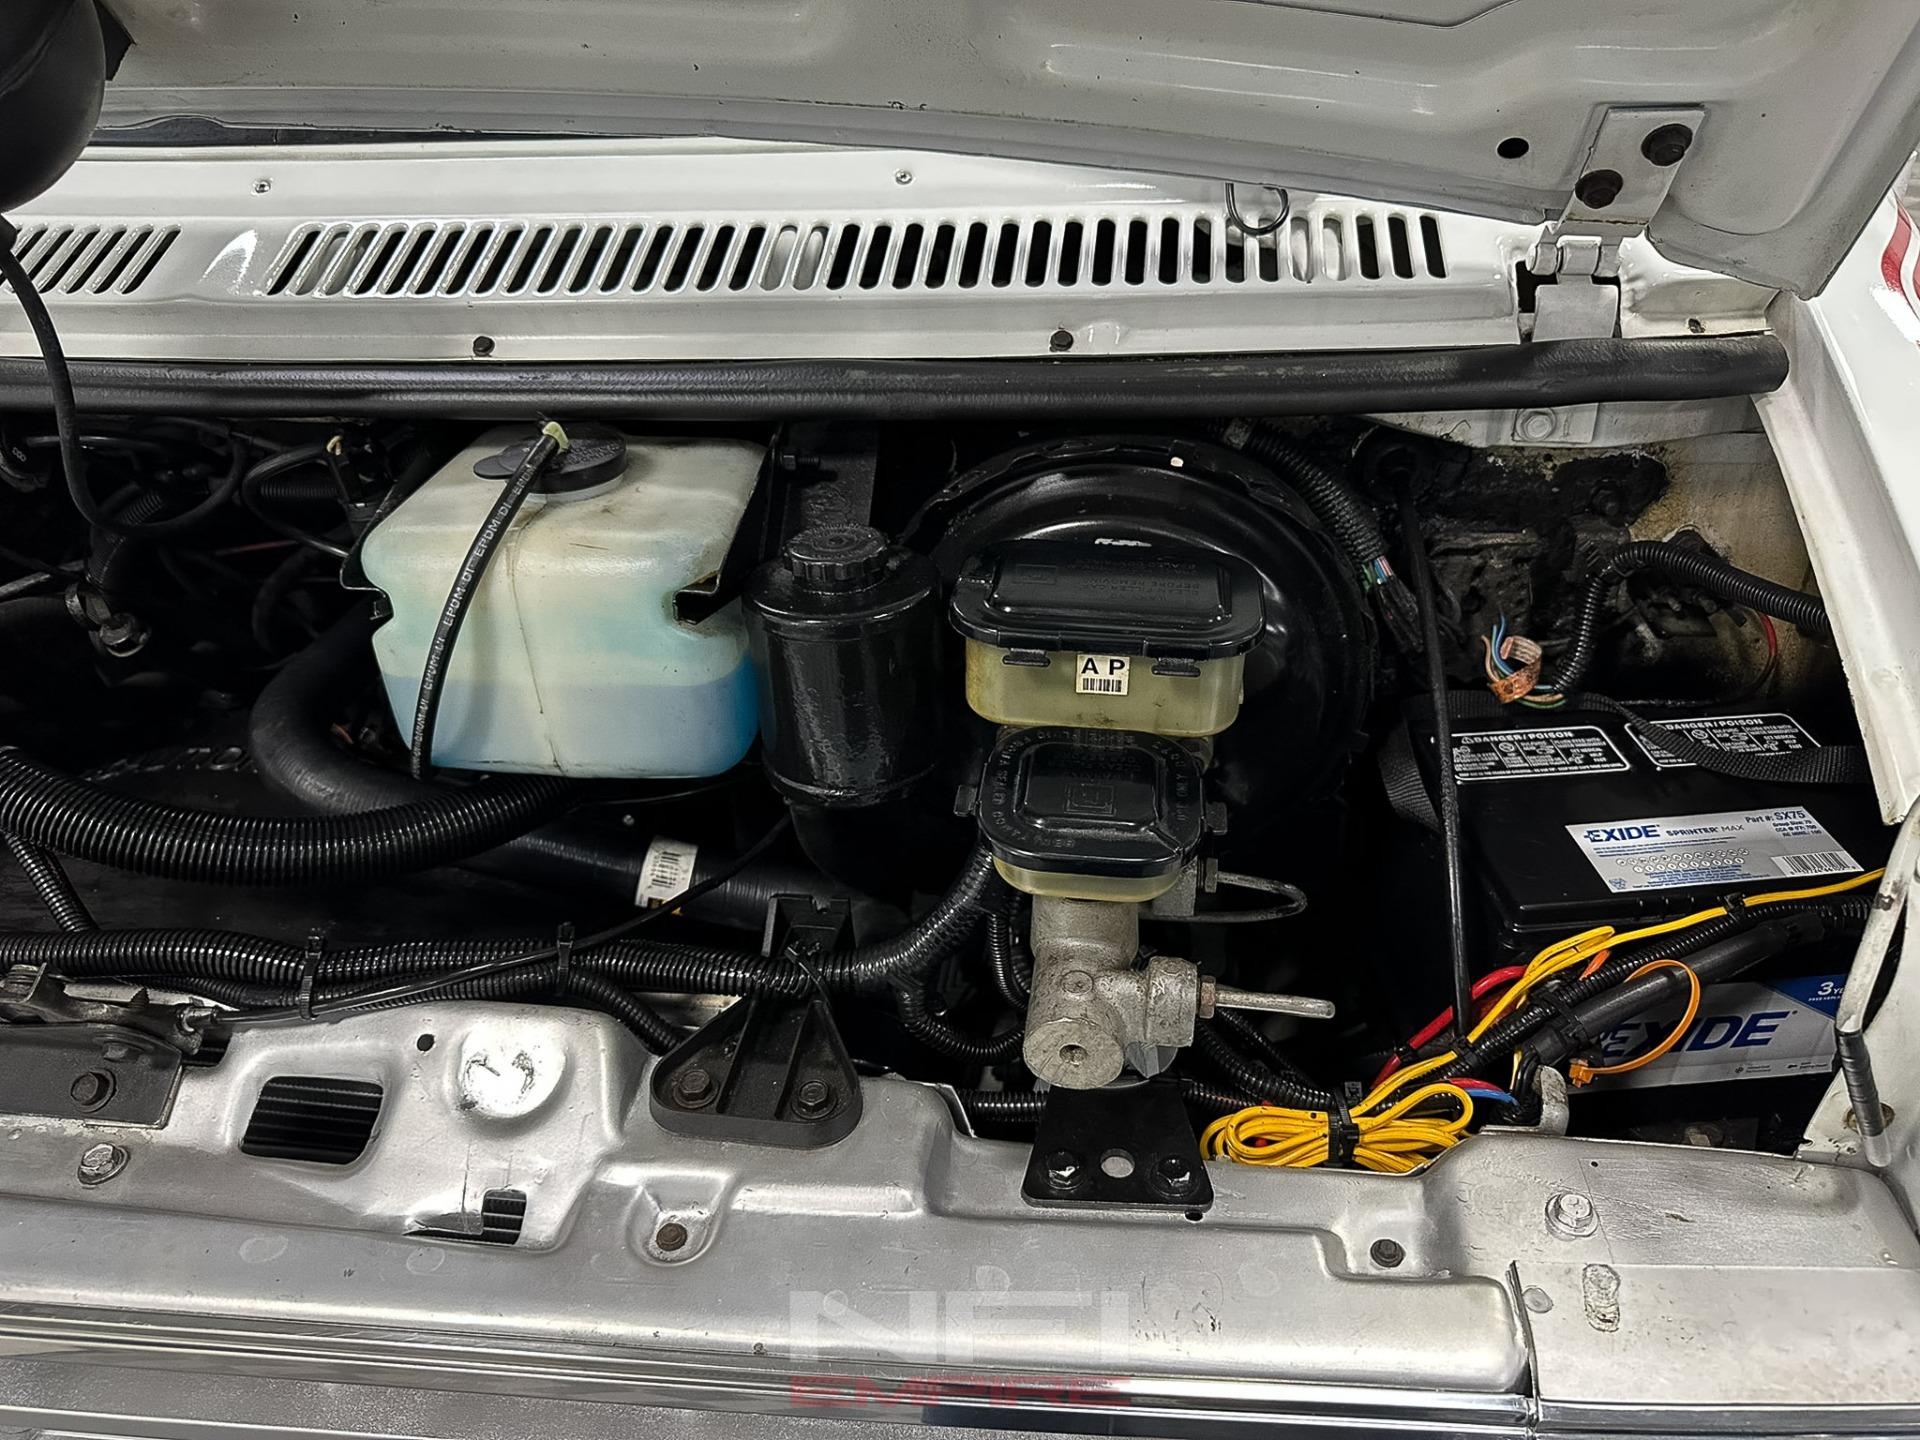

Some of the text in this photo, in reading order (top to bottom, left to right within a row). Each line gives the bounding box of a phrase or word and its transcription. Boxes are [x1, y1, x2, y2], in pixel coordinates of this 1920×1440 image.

[1081, 658, 1125, 675] A P
[1774, 811, 1806, 820] SX75
[1584, 824, 1660, 842] EXIDE
[1666, 826, 1716, 836] SPRINTER
[1818, 981, 1834, 996] 3
